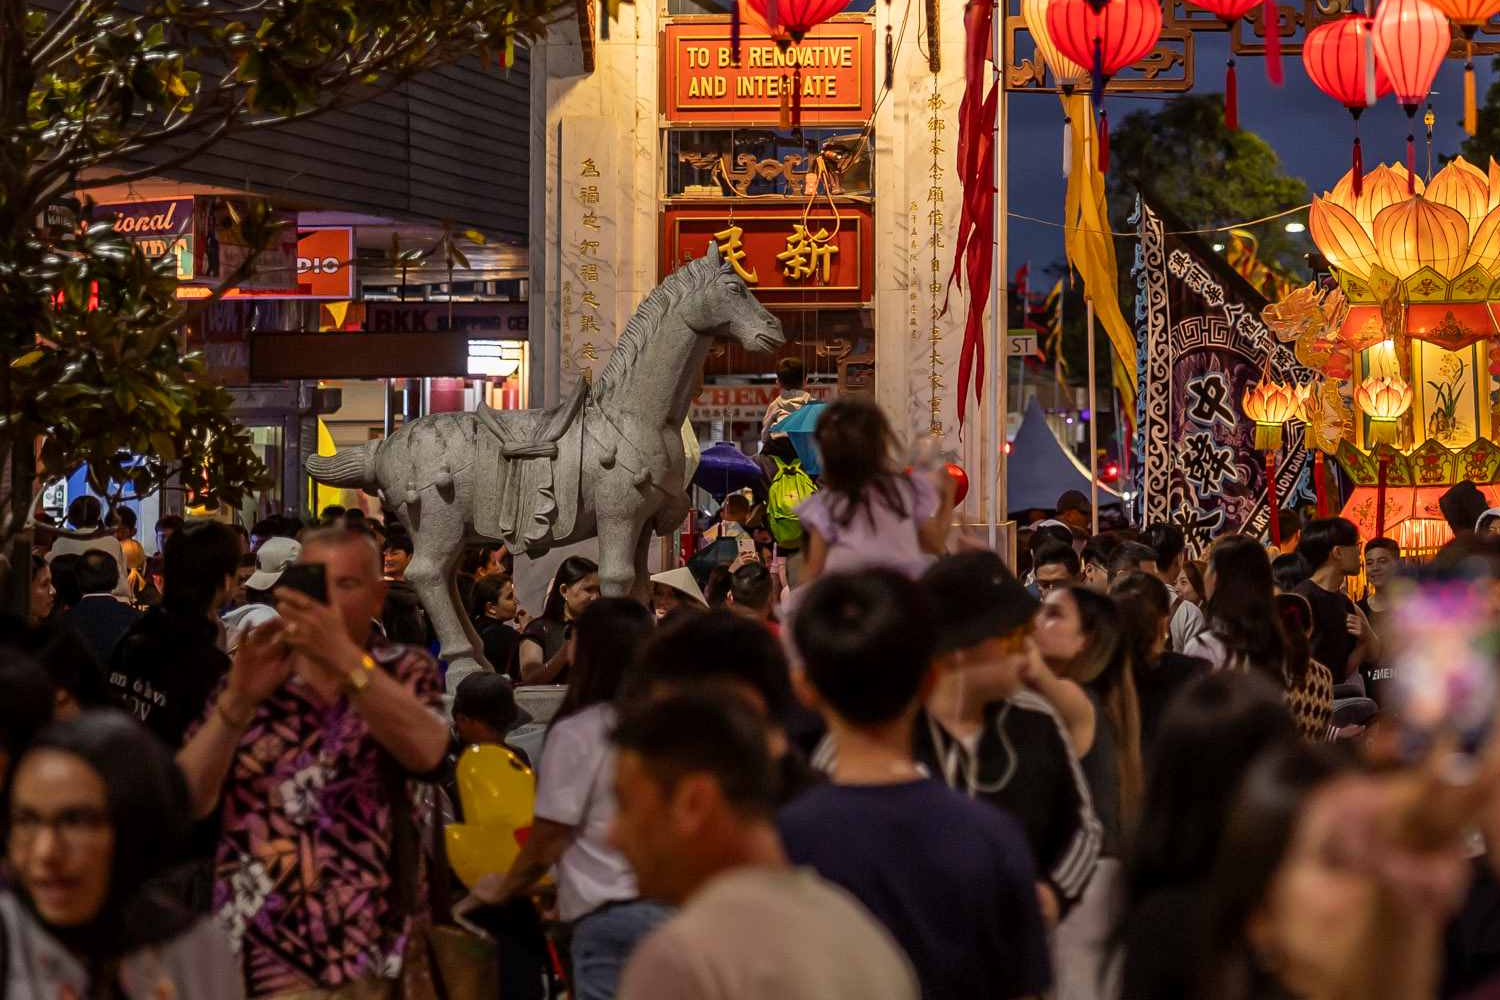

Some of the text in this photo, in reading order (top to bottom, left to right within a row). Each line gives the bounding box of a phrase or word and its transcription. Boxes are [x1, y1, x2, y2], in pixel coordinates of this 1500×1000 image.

[687, 47, 710, 68] TO
[750, 46, 852, 68] RENOVATIVE
[689, 75, 837, 98] AND INTEGATE
[1012, 337, 1033, 353] ST
